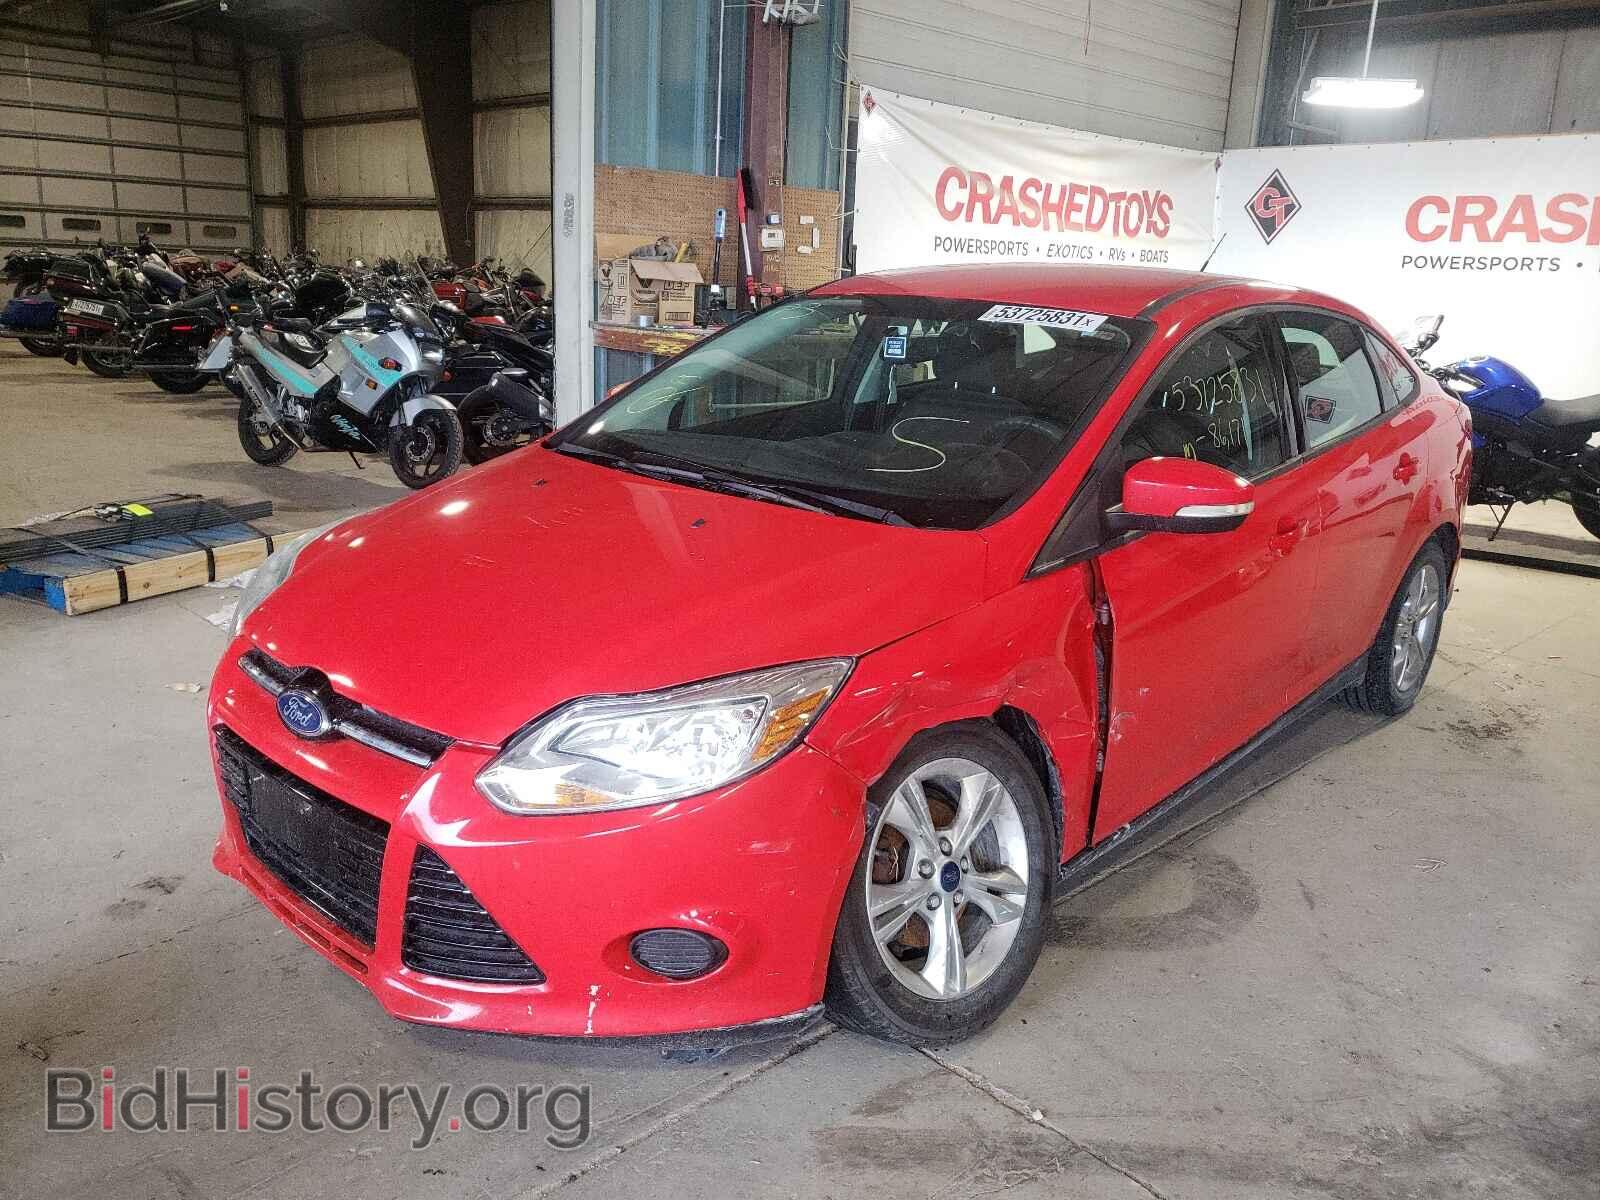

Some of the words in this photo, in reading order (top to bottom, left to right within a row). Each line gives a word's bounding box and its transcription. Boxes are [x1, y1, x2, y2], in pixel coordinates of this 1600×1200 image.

[935, 166, 1174, 238] CRASHEDTOYS
[934, 235, 1029, 257] POWERSPORTS
[1047, 243, 1094, 259] EXOTICS
[1108, 247, 1127, 262] RVs
[1140, 249, 1169, 264] BOATS
[1401, 254, 1562, 273] POWERSPORTS
[283, 696, 313, 727] Ford
